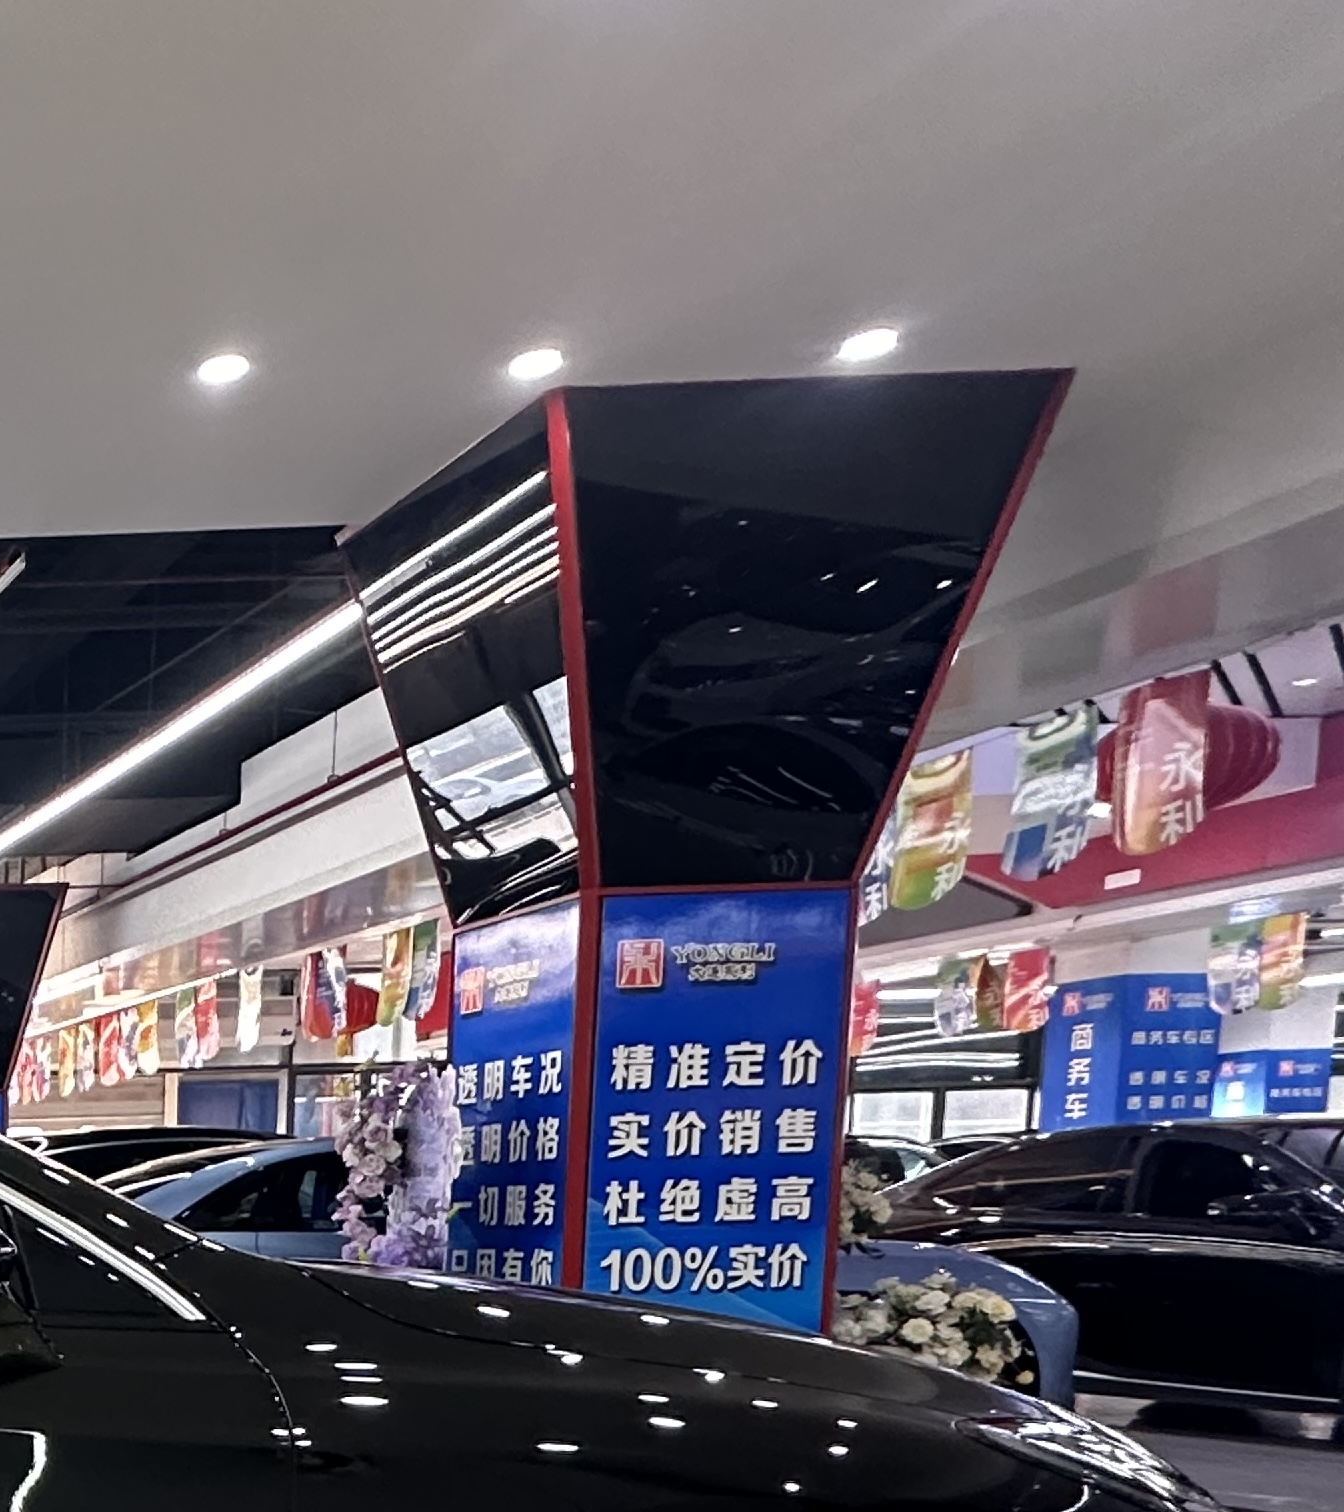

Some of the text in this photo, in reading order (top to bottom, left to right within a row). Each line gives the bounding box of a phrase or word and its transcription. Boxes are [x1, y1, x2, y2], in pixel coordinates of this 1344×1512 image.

[1160, 742, 1205, 846] 永利
[931, 811, 972, 902] 永利
[671, 943, 776, 964] YONGLI
[457, 1050, 562, 1105] 透明车况
[610, 1038, 824, 1091] 精准定价
[1064, 1022, 1095, 1120] 商务车
[460, 1116, 560, 1166] 透明价格
[607, 1107, 818, 1159] 实价销售
[452, 1182, 556, 1226] 一切服务
[603, 1176, 814, 1226] 杜绝虚高
[600, 1242, 808, 1292] 100%实价
